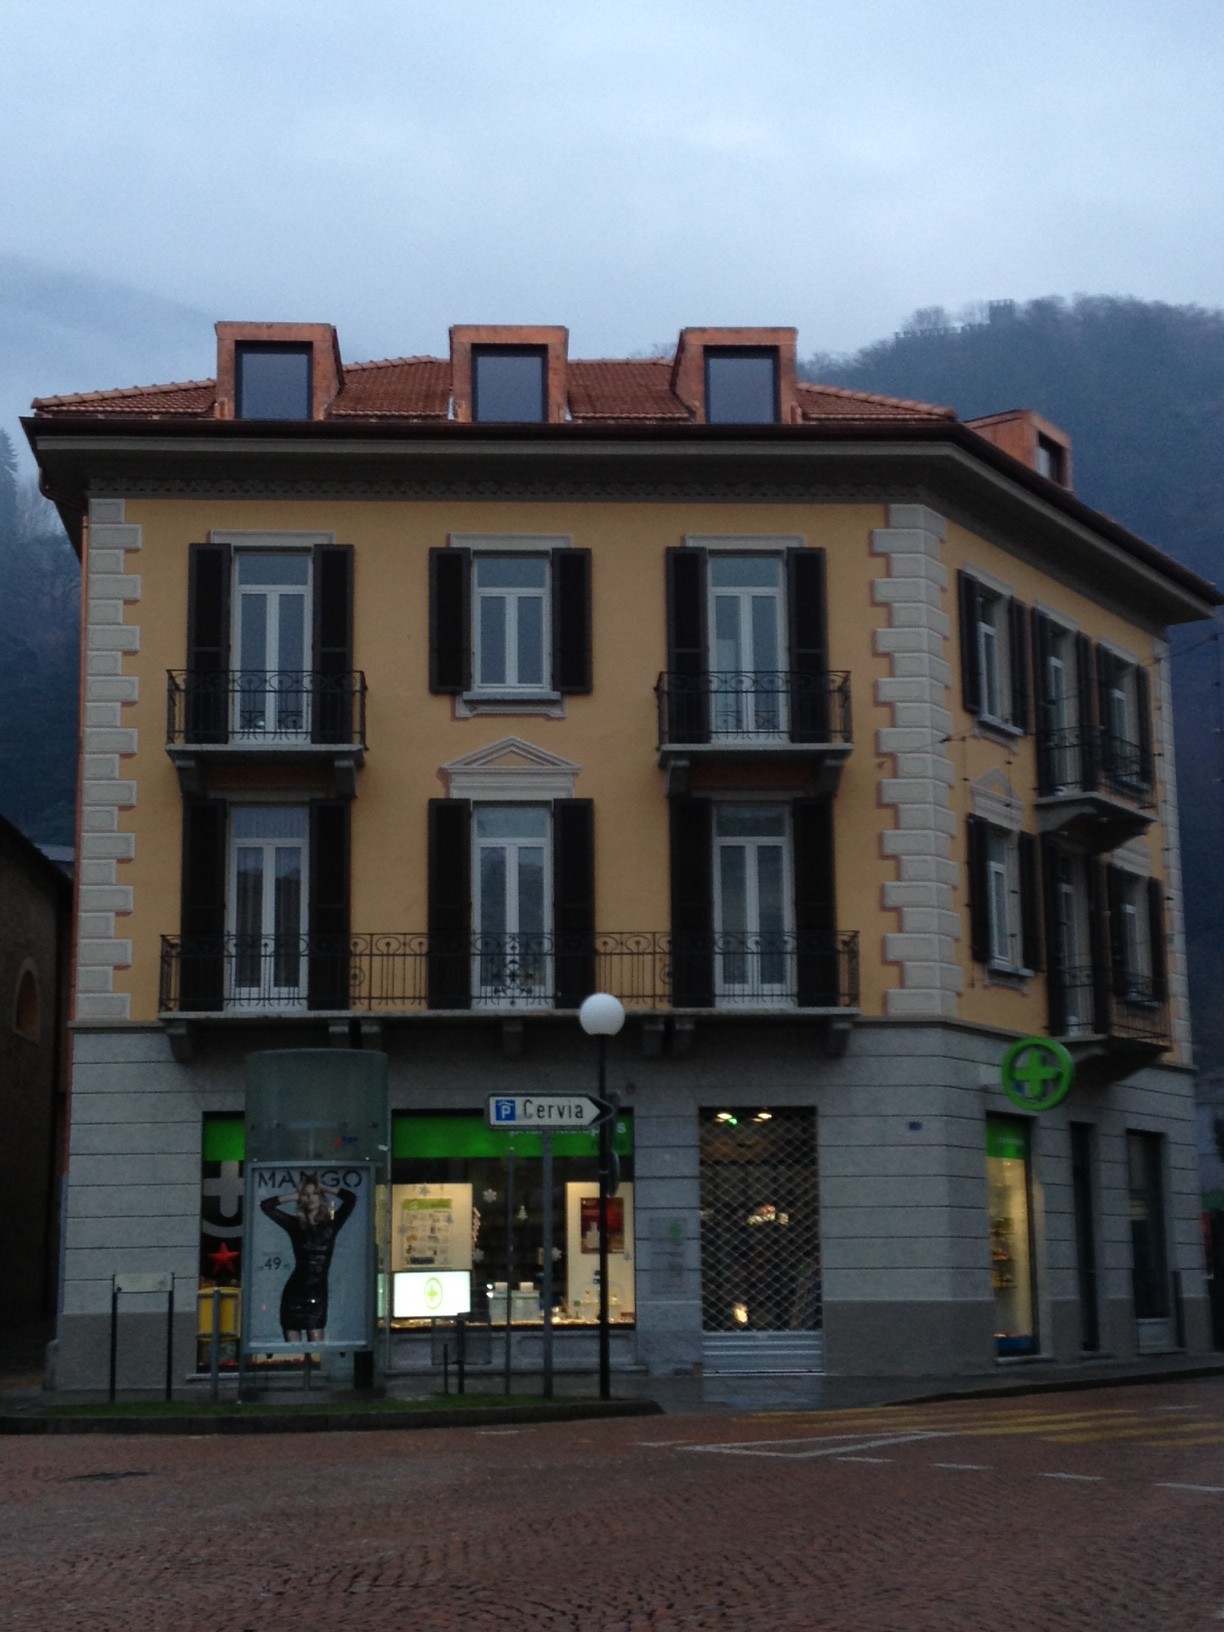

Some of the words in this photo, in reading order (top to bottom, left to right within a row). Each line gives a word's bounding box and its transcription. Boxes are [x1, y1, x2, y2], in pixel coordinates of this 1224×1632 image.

[501, 1104, 511, 1119] P
[523, 1099, 584, 1119] Cervia
[264, 1256, 282, 1271] 49
